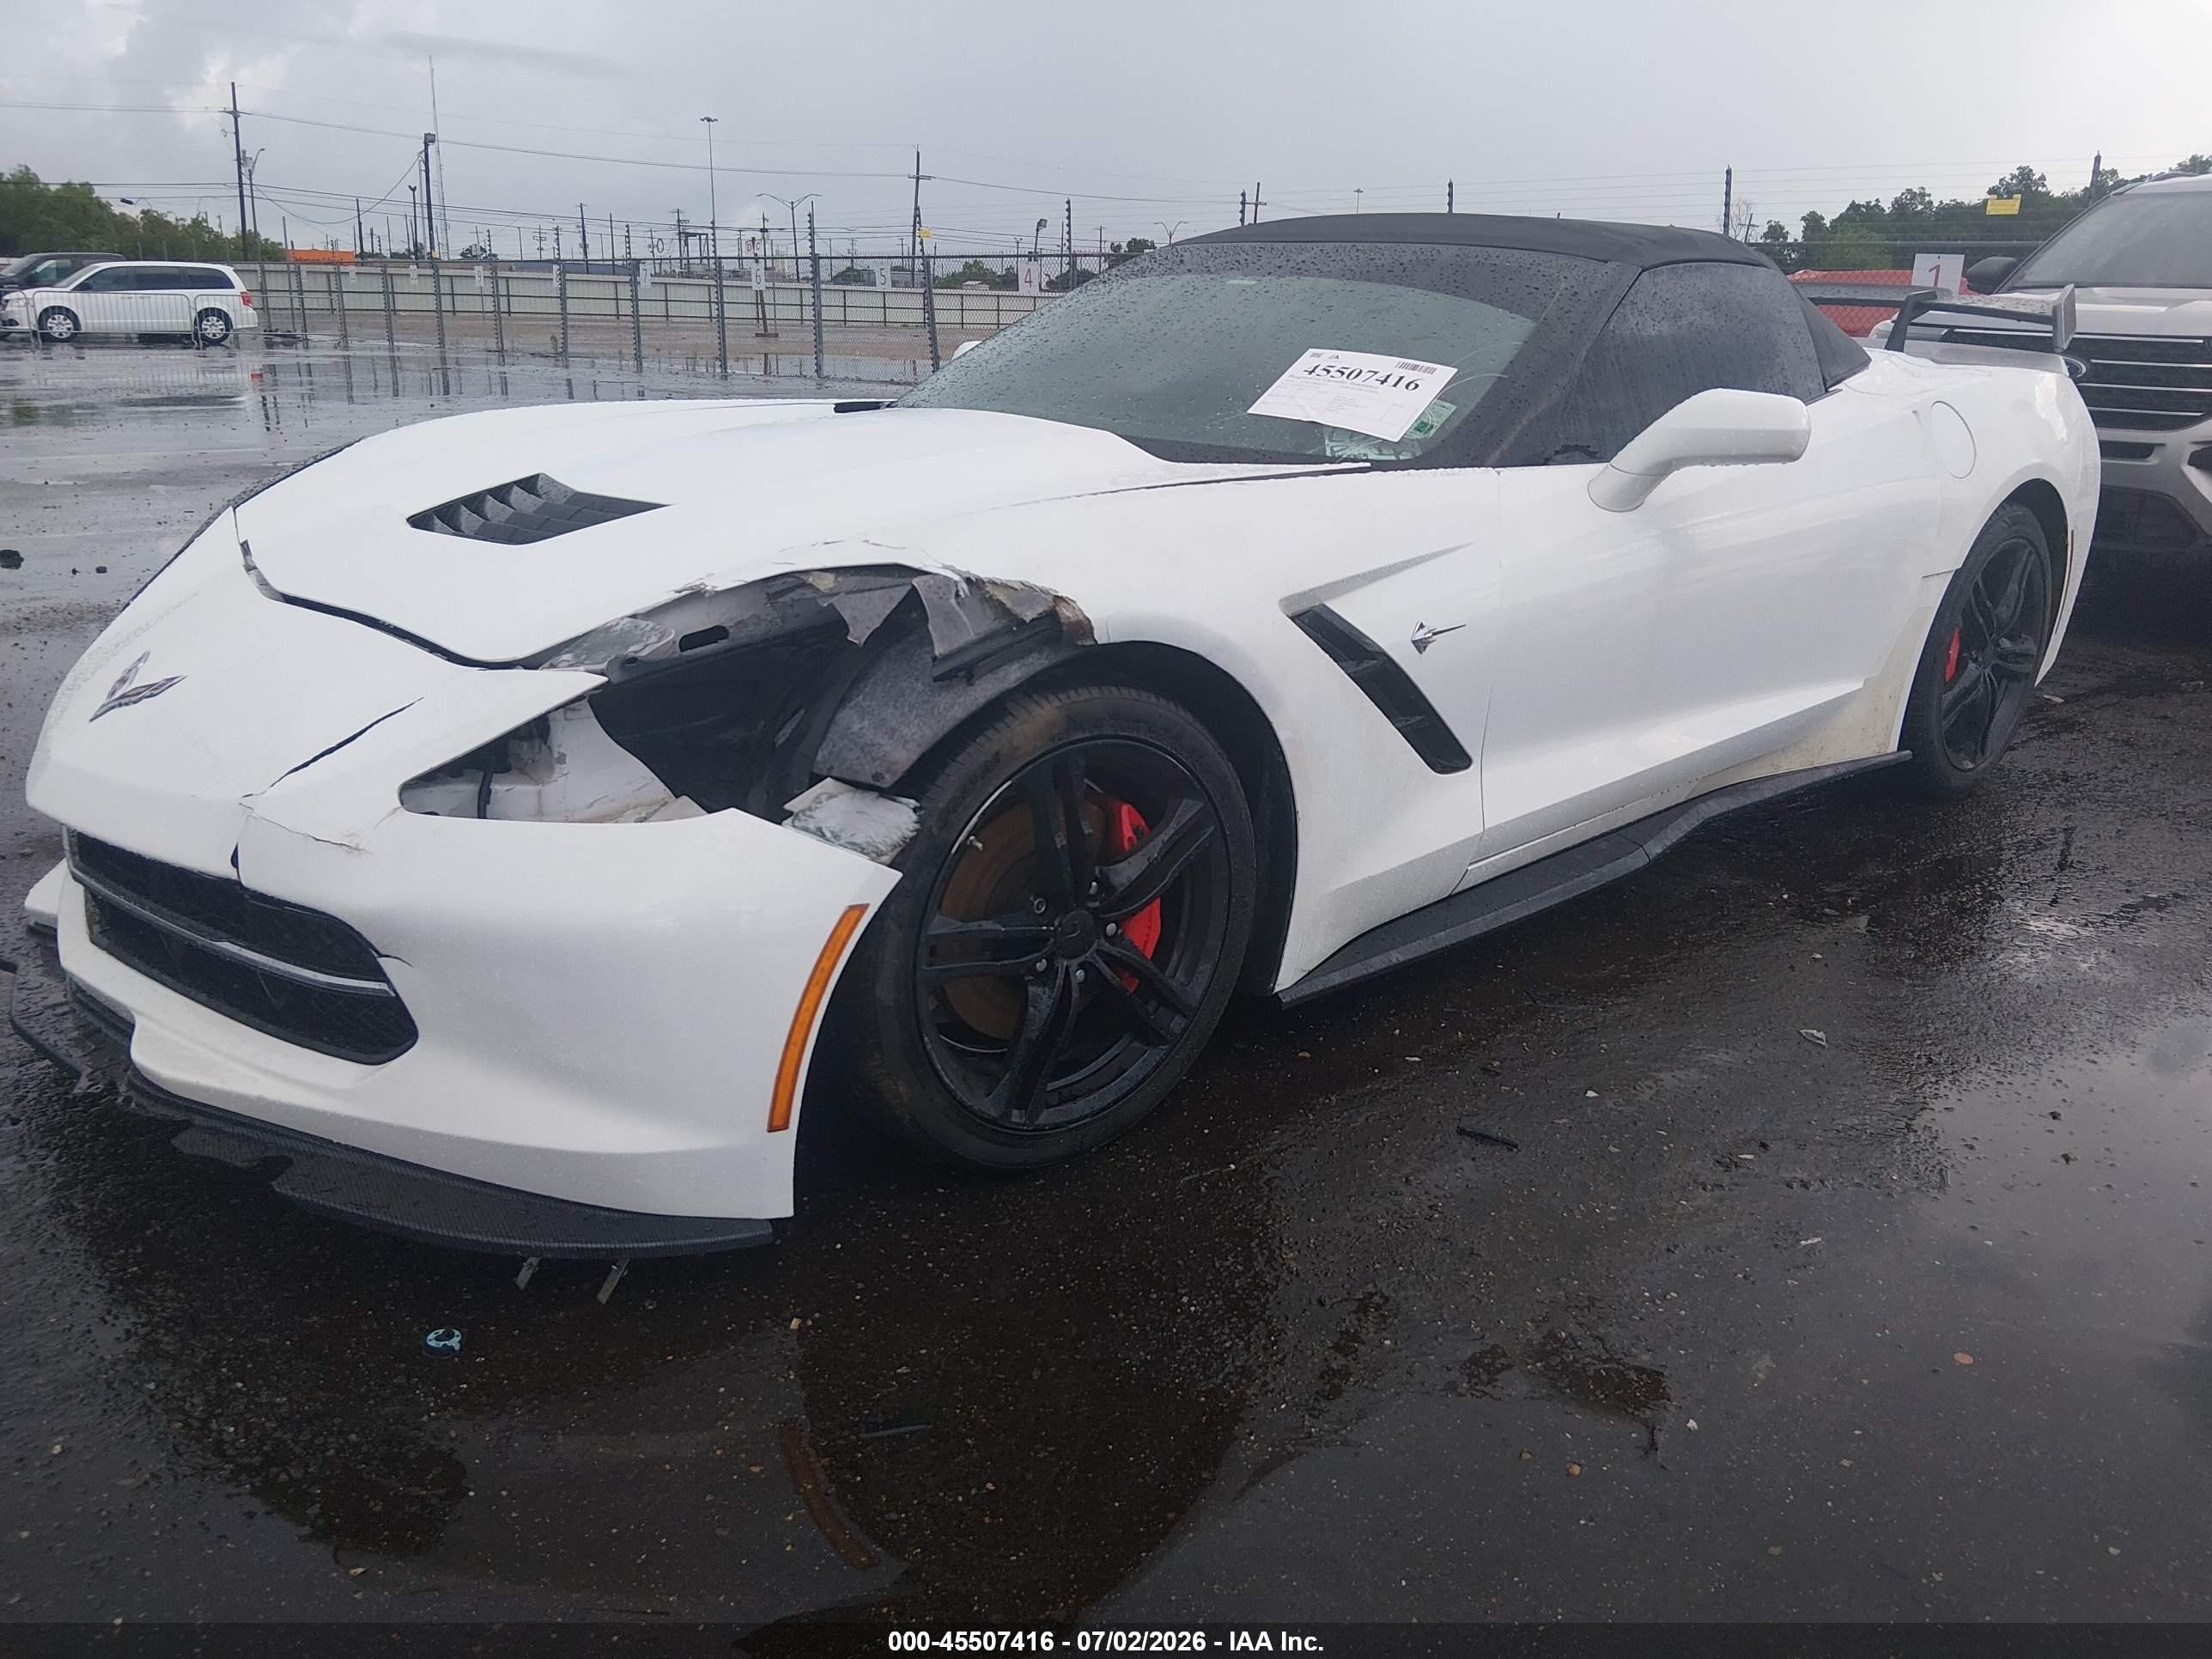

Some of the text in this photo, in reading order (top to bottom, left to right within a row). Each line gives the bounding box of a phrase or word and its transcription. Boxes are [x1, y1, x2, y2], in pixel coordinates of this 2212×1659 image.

[755, 268, 762, 285] 6
[879, 267, 886, 285] 5
[1024, 267, 1033, 288] 4
[1929, 264, 1941, 289] 1
[1303, 363, 1424, 392] 45507416
